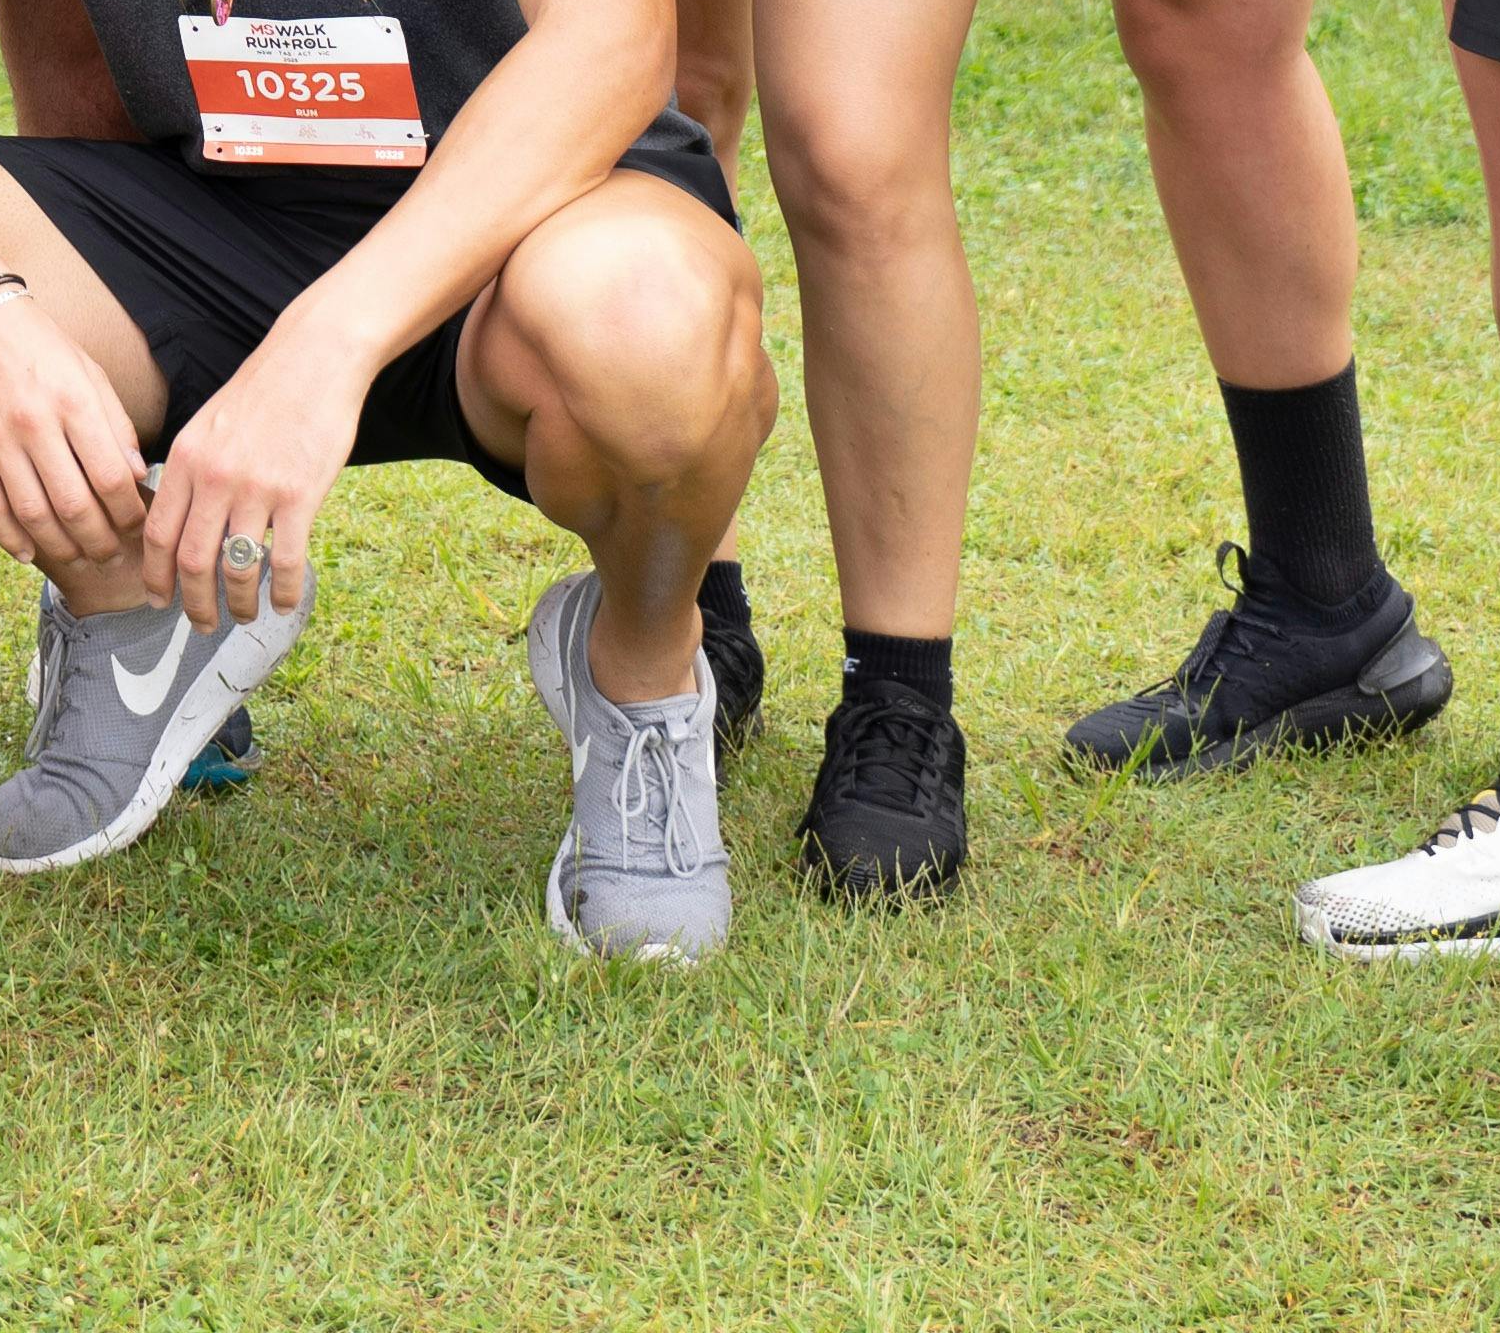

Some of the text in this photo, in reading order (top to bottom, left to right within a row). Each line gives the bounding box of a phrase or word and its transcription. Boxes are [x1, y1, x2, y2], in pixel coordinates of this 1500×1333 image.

[250, 24, 326, 36] MS WALK
[246, 37, 337, 49] RUN+ROLL
[236, 69, 366, 102] 10325
[295, 108, 318, 117] RUN
